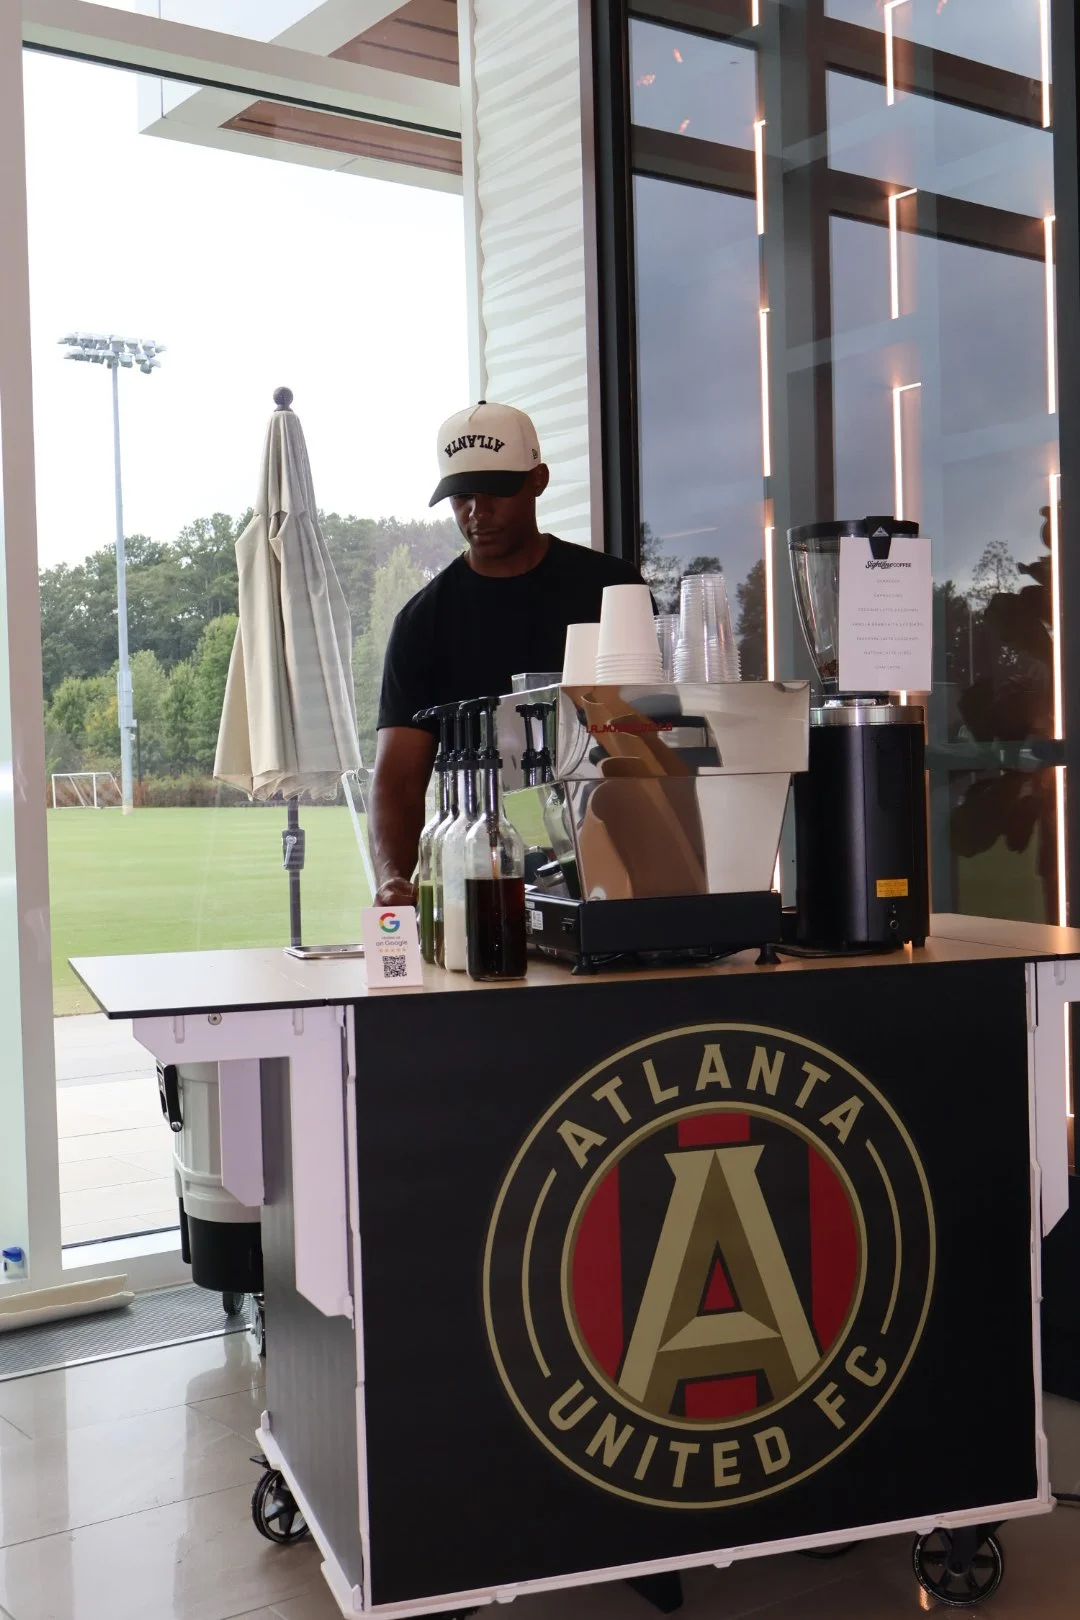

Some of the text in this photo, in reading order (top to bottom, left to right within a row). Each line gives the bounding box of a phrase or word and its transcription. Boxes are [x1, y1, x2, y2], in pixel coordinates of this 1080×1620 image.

[444, 434, 505, 458] ATLANTA
[379, 912, 400, 933] G
[556, 1043, 865, 1170] ATLANTA
[547, 1344, 888, 1489] UNITED FC
